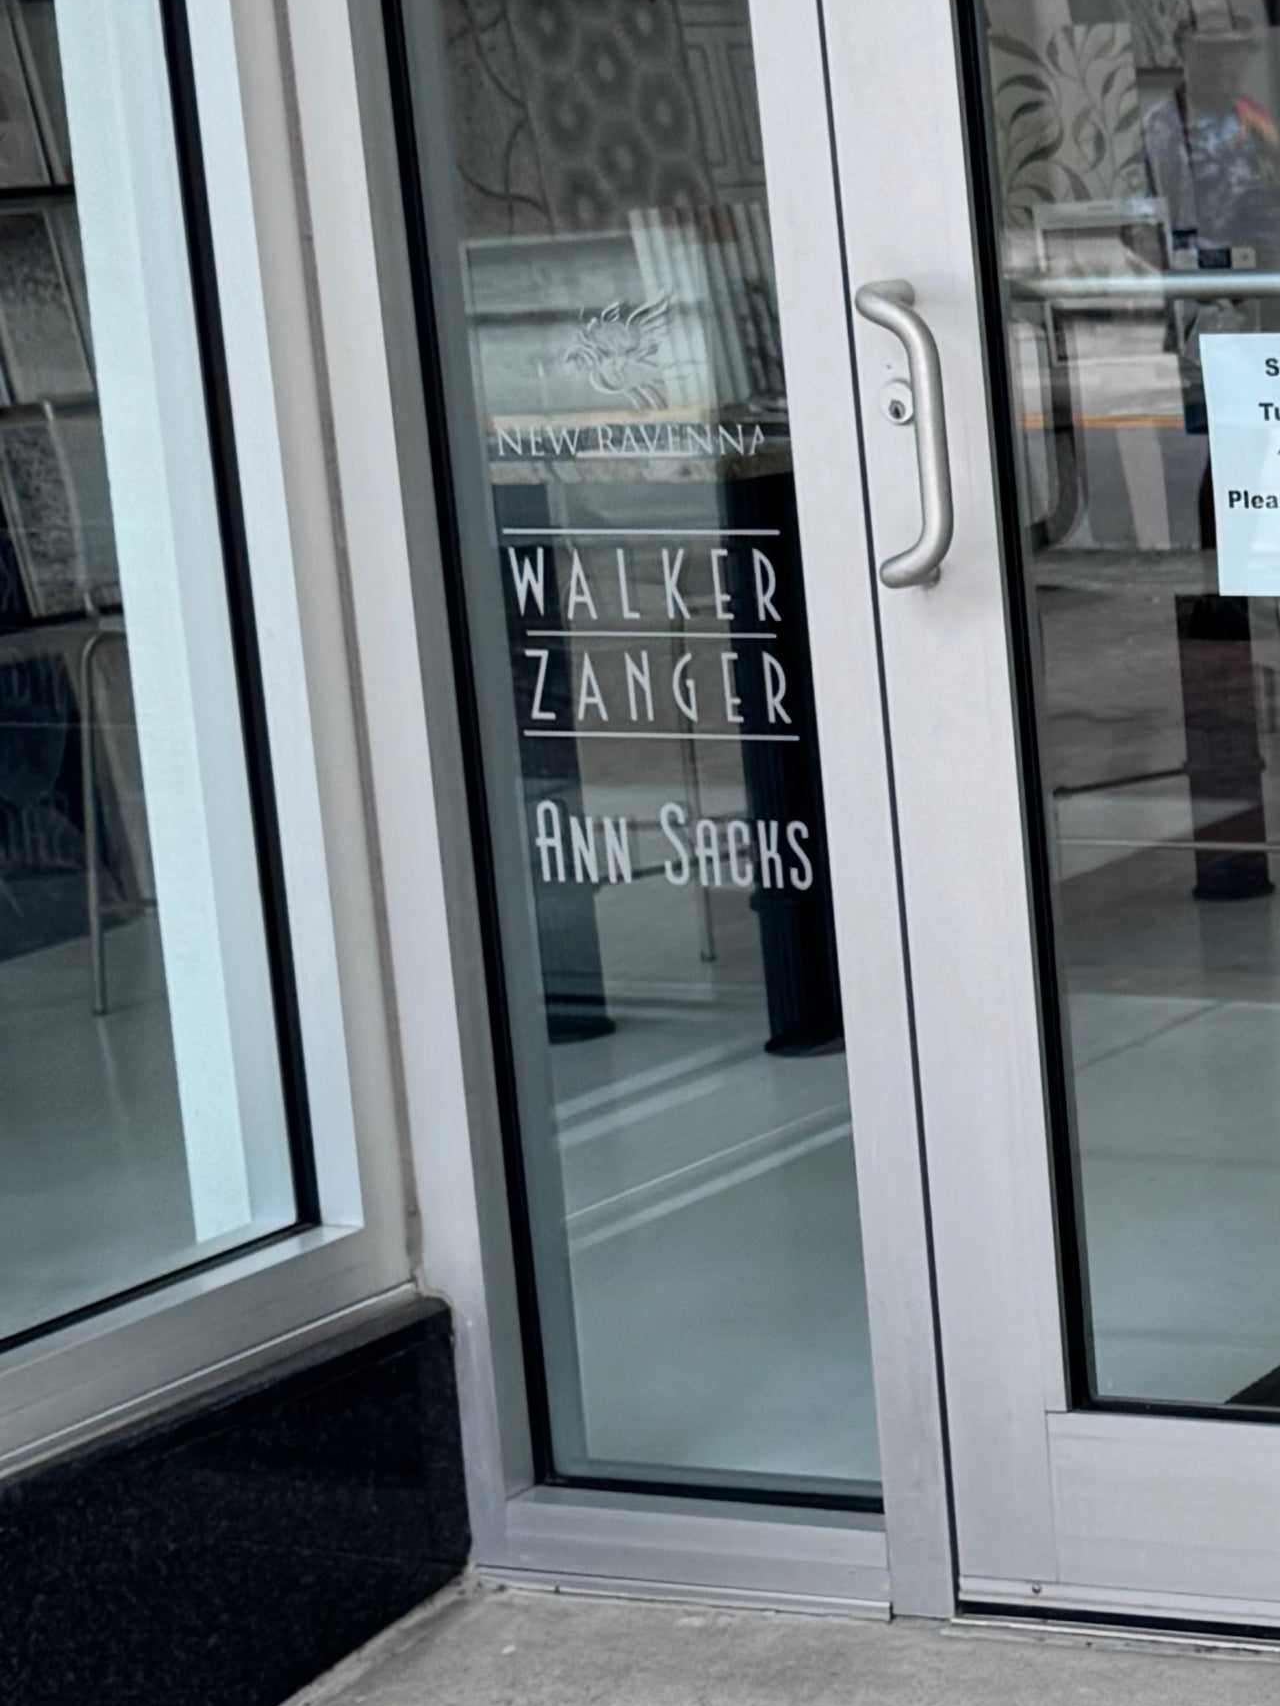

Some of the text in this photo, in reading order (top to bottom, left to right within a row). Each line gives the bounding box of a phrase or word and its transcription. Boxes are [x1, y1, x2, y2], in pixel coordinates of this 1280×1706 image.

[497, 423, 766, 457] NEW RAVENNA
[506, 546, 782, 622] WALKER
[523, 648, 793, 725] ZANGER
[535, 799, 633, 885] ANN
